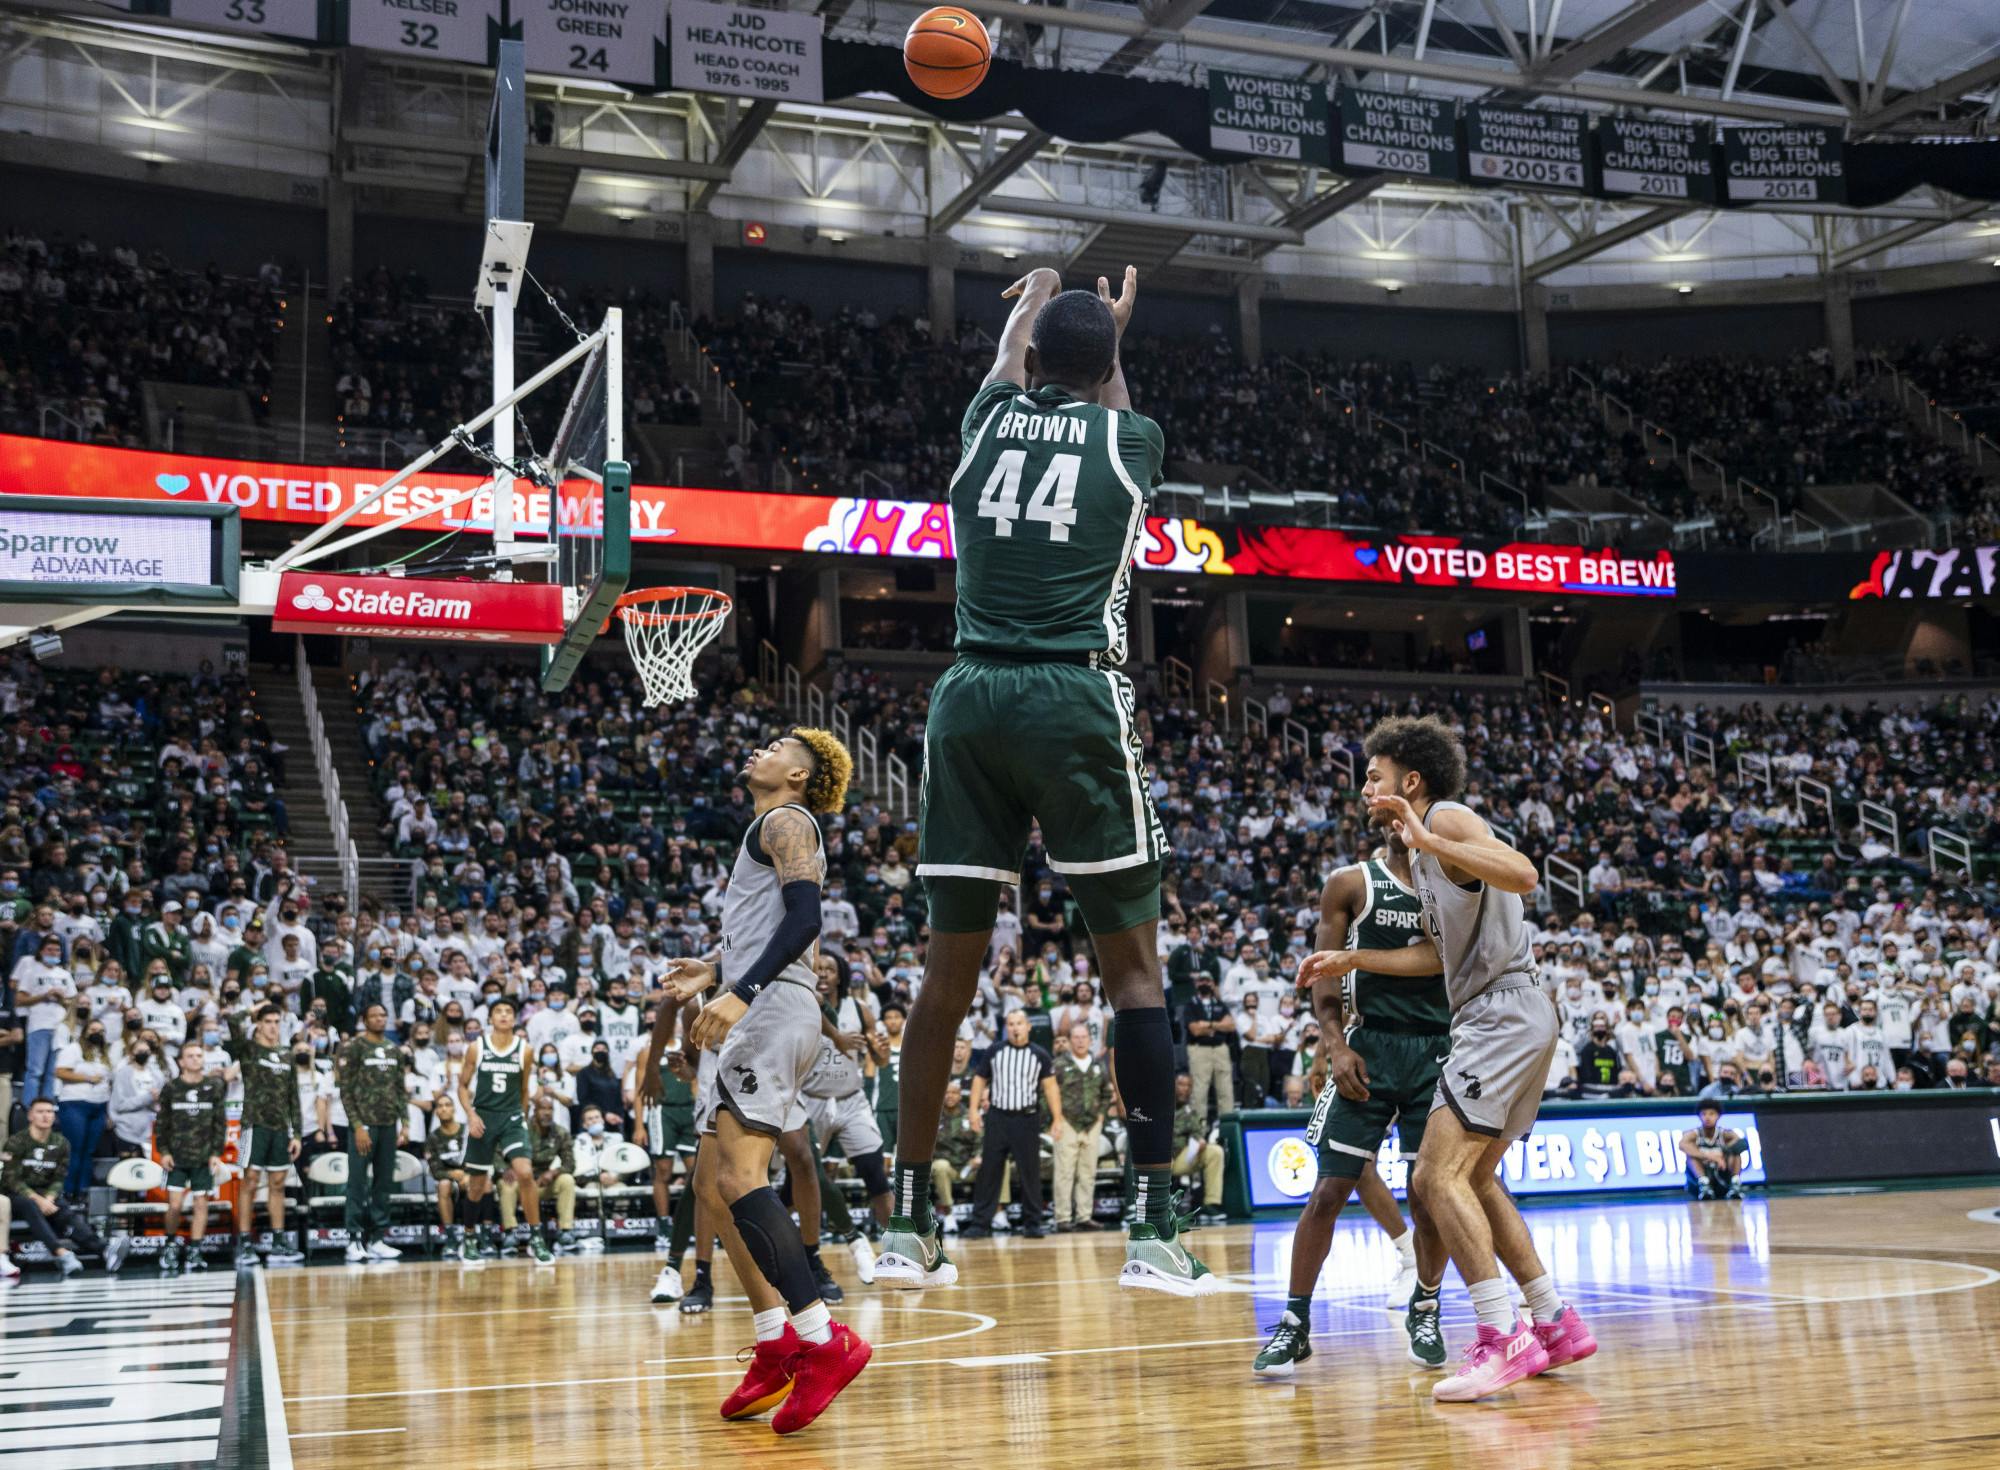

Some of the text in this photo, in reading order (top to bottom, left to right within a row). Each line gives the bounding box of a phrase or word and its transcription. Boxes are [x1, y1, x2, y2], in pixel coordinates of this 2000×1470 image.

[547, 0, 629, 19] JOHNNY
[556, 17, 623, 39] GREEN
[727, 13, 766, 30] JUD
[401, 21, 439, 50] 32
[687, 27, 807, 56] HEATHCOTE
[568, 45, 610, 73] 24
[694, 53, 800, 76] HEAD COACH
[705, 71, 741, 87] 1976
[755, 77, 790, 92] 1995
[1224, 75, 1312, 101] WOMEN'S
[1234, 95, 1305, 117] BIG TEN
[1355, 91, 1440, 118] WOMEN'S
[1213, 108, 1327, 137] CHAMPIONS
[1366, 111, 1433, 134] BIG TEN
[1479, 110, 1546, 128] WOMEN'S
[1346, 124, 1455, 152] CHAMPIONS
[1480, 124, 1579, 145] TOURNAMENT
[1614, 119, 1696, 144] WOMEN'S
[1738, 129, 1826, 145] WOMEN'S
[1248, 135, 1294, 155] 1997
[1480, 137, 1582, 161] CHAMPIONS
[1624, 139, 1689, 158] BIG TEN
[1749, 147, 1819, 161] BIG TEN
[1376, 150, 1428, 171] 2005
[1502, 159, 1560, 181] 2005
[1605, 151, 1711, 175] CHAMPIONS
[1729, 162, 1842, 177] CHAMPIONS
[1640, 176, 1680, 194] 2011
[1763, 181, 1811, 198] 2014
[996, 411, 1087, 444] BROWN
[200, 472, 339, 512] VOTED
[350, 482, 460, 519] BEST
[978, 449, 1082, 542] 44
[31, 555, 163, 577] ADVANTAGE
[1384, 545, 1487, 578] VOTED
[1495, 552, 1570, 583] BEST
[1375, 908, 1425, 929] SPART
[492, 1073, 507, 1093] 5
[1582, 1127, 1627, 1184] $1
[606, 1218, 656, 1230] ROCKET
